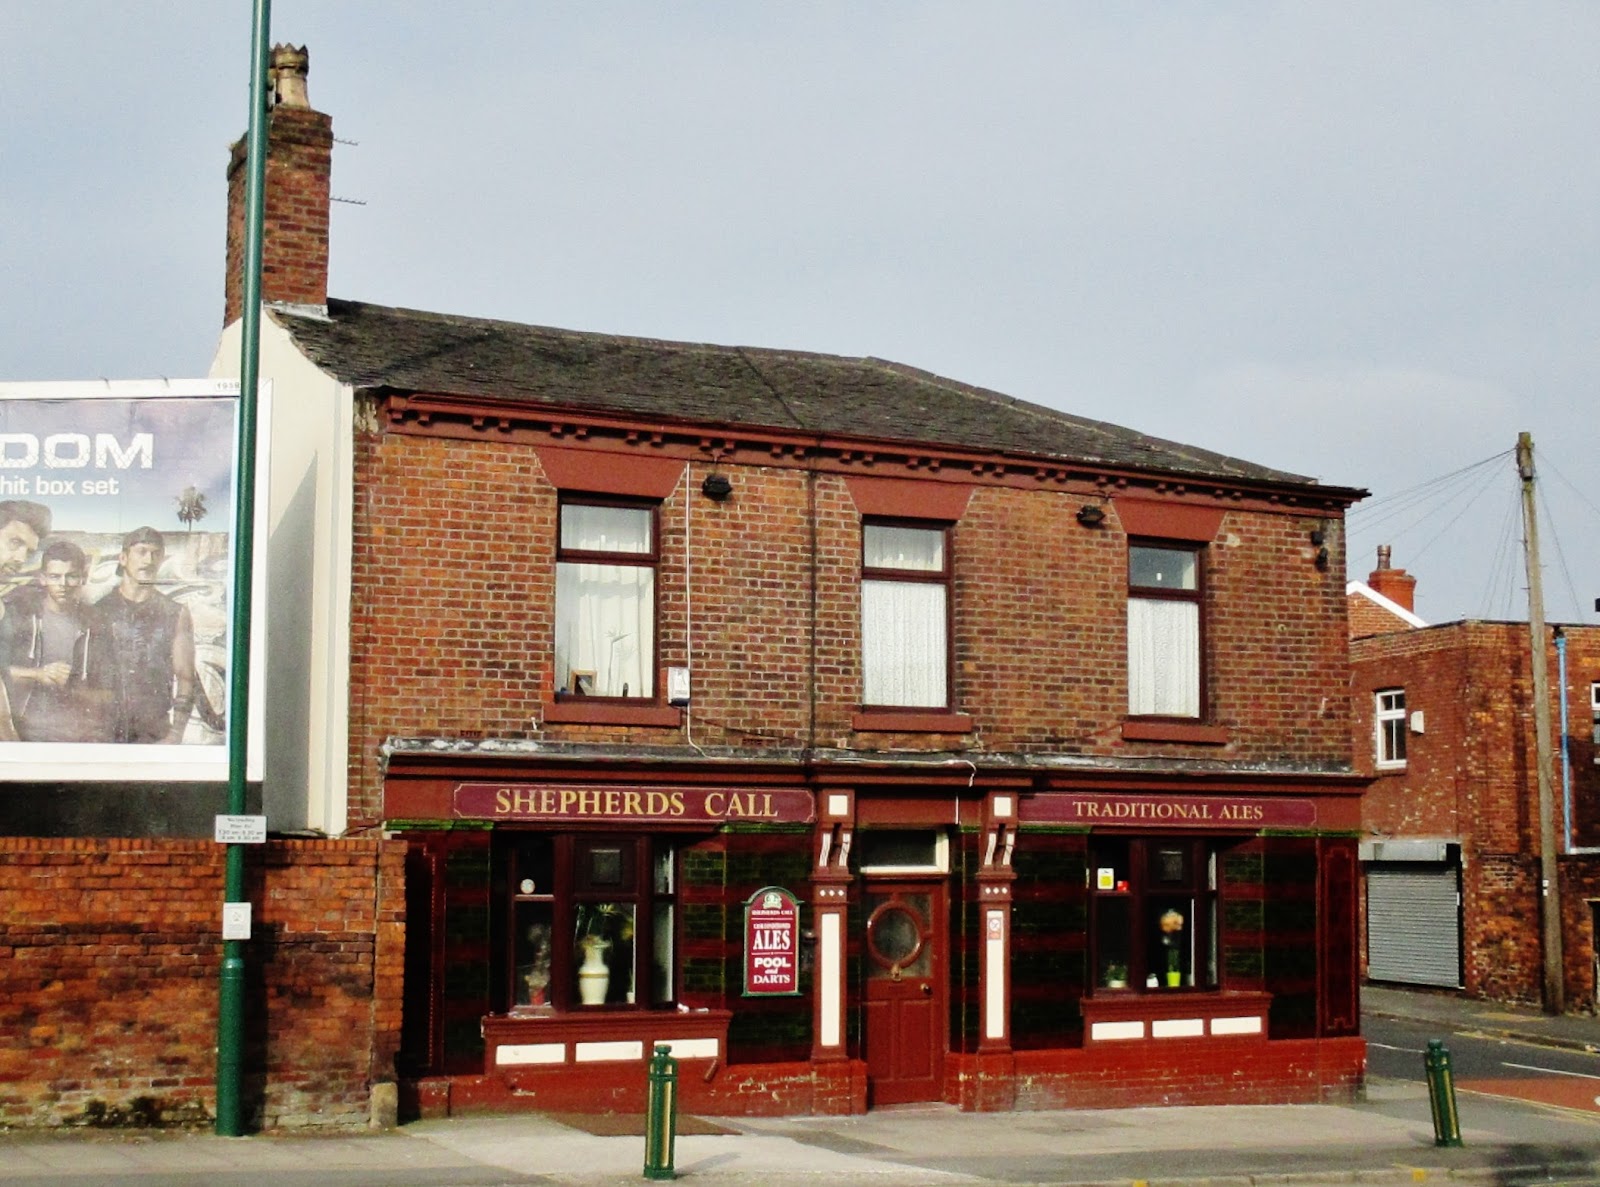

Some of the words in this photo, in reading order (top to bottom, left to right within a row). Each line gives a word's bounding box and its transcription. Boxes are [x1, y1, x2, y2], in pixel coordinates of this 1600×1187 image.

[0, 475, 29, 495] hit
[36, 475, 75, 495] box
[81, 477, 119, 495] set
[495, 788, 685, 816] SHEPHERDS
[704, 792, 778, 817] CALL
[1072, 801, 1213, 819] TRADITIONAL
[1218, 804, 1263, 820] ALES
[753, 929, 791, 950] ALES
[754, 957, 792, 968] POOL
[753, 974, 790, 984] DARTS
